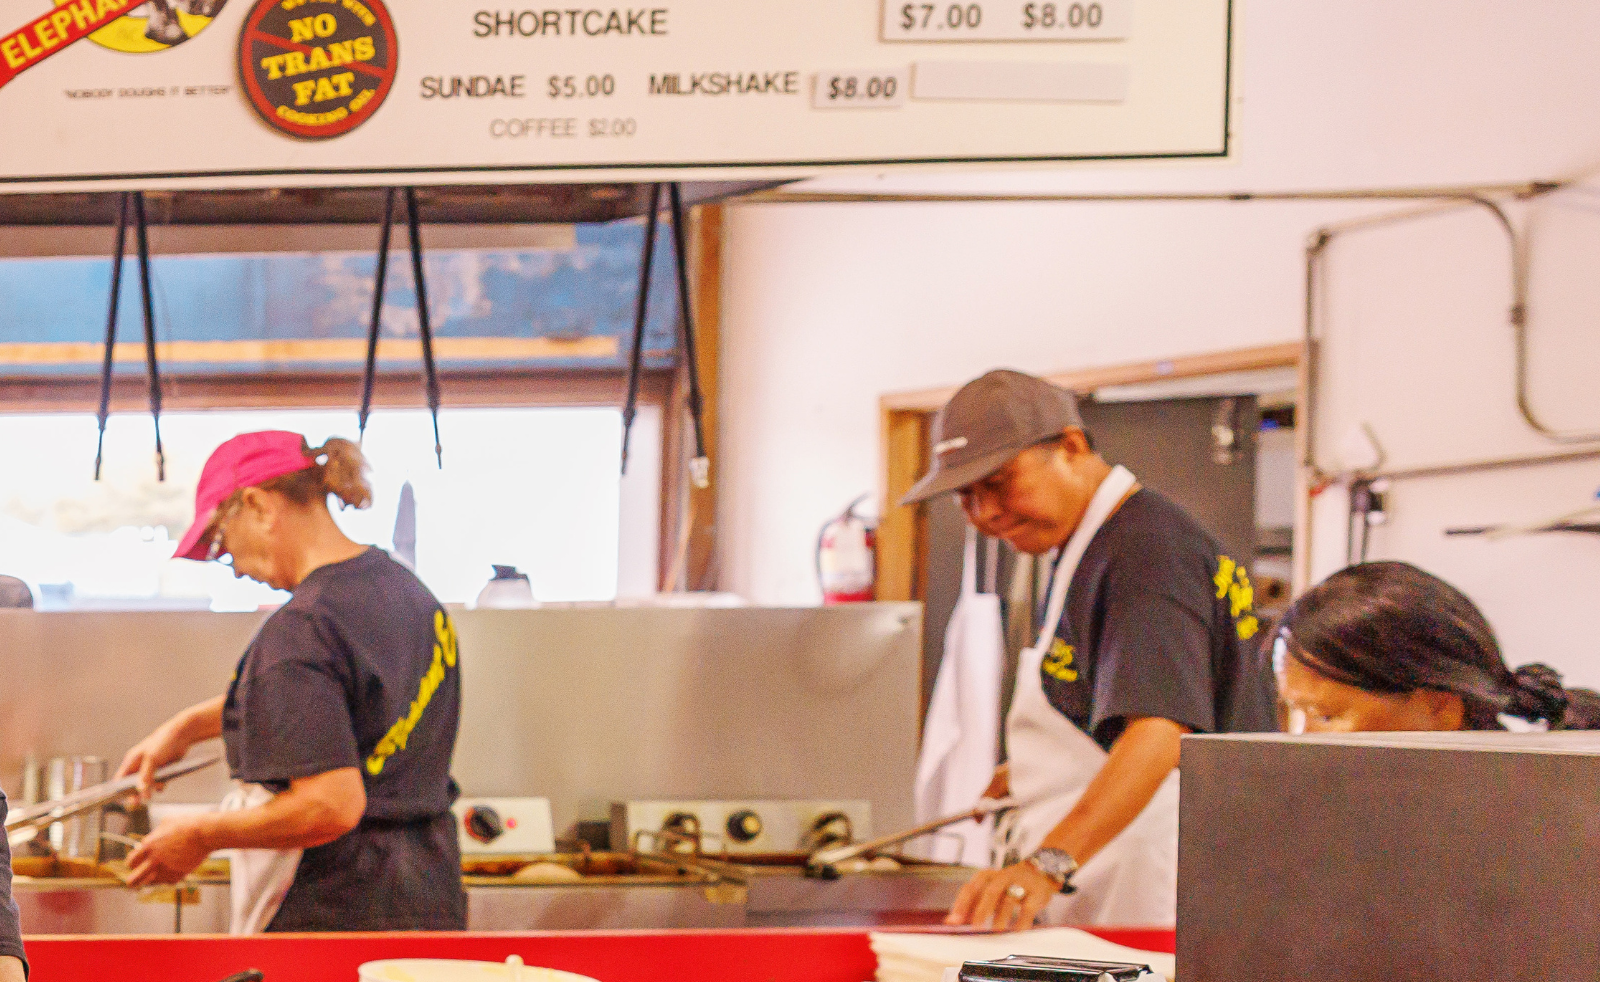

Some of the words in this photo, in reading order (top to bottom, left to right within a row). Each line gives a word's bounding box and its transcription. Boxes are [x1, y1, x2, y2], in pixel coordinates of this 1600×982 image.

[288, 13, 337, 43] NO
[473, 9, 668, 37] SHORTCAKE
[901, 3, 982, 31] $7.00
[1023, 2, 1103, 30] $8.00
[261, 36, 376, 80] TRANS
[292, 72, 355, 106] FAT
[420, 75, 526, 99] SUNDAE
[547, 74, 615, 97] $5.00
[648, 71, 800, 95] MILKSHAKE
[828, 76, 898, 100] $8.00
[490, 118, 578, 139] COFFEE
[589, 117, 638, 138] $2.00
